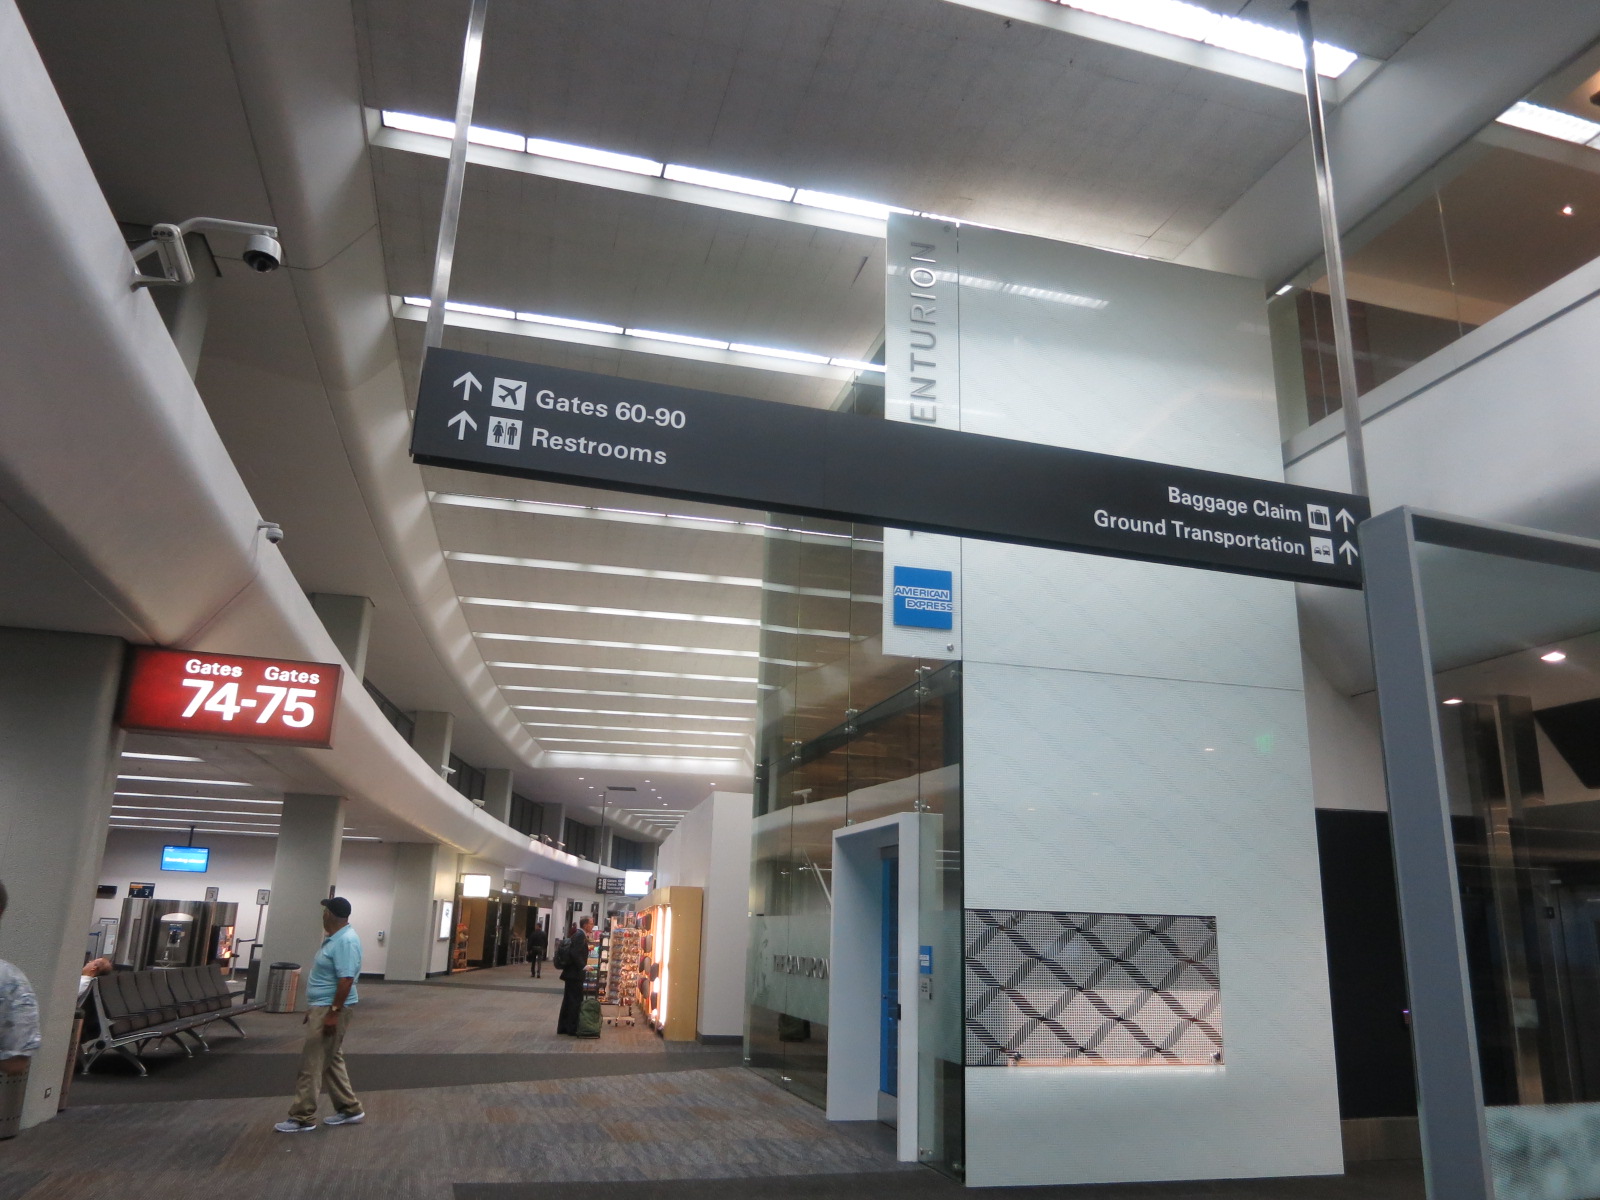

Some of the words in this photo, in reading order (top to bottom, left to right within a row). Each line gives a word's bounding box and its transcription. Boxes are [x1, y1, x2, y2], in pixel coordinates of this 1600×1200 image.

[910, 241, 937, 423] ENTURION
[535, 389, 608, 418] Gates
[615, 401, 686, 430] 60-90
[531, 427, 667, 465] Restrooms
[1168, 486, 1248, 516] Baggage
[1253, 499, 1302, 523] Claim
[1093, 509, 1167, 537] Ground
[1171, 520, 1305, 556] Transportation
[894, 585, 950, 600] AMERICAN
[905, 598, 953, 613] EXPRESS
[185, 658, 243, 678] Gates
[264, 666, 320, 685] Gates
[181, 678, 317, 728] 74-75
